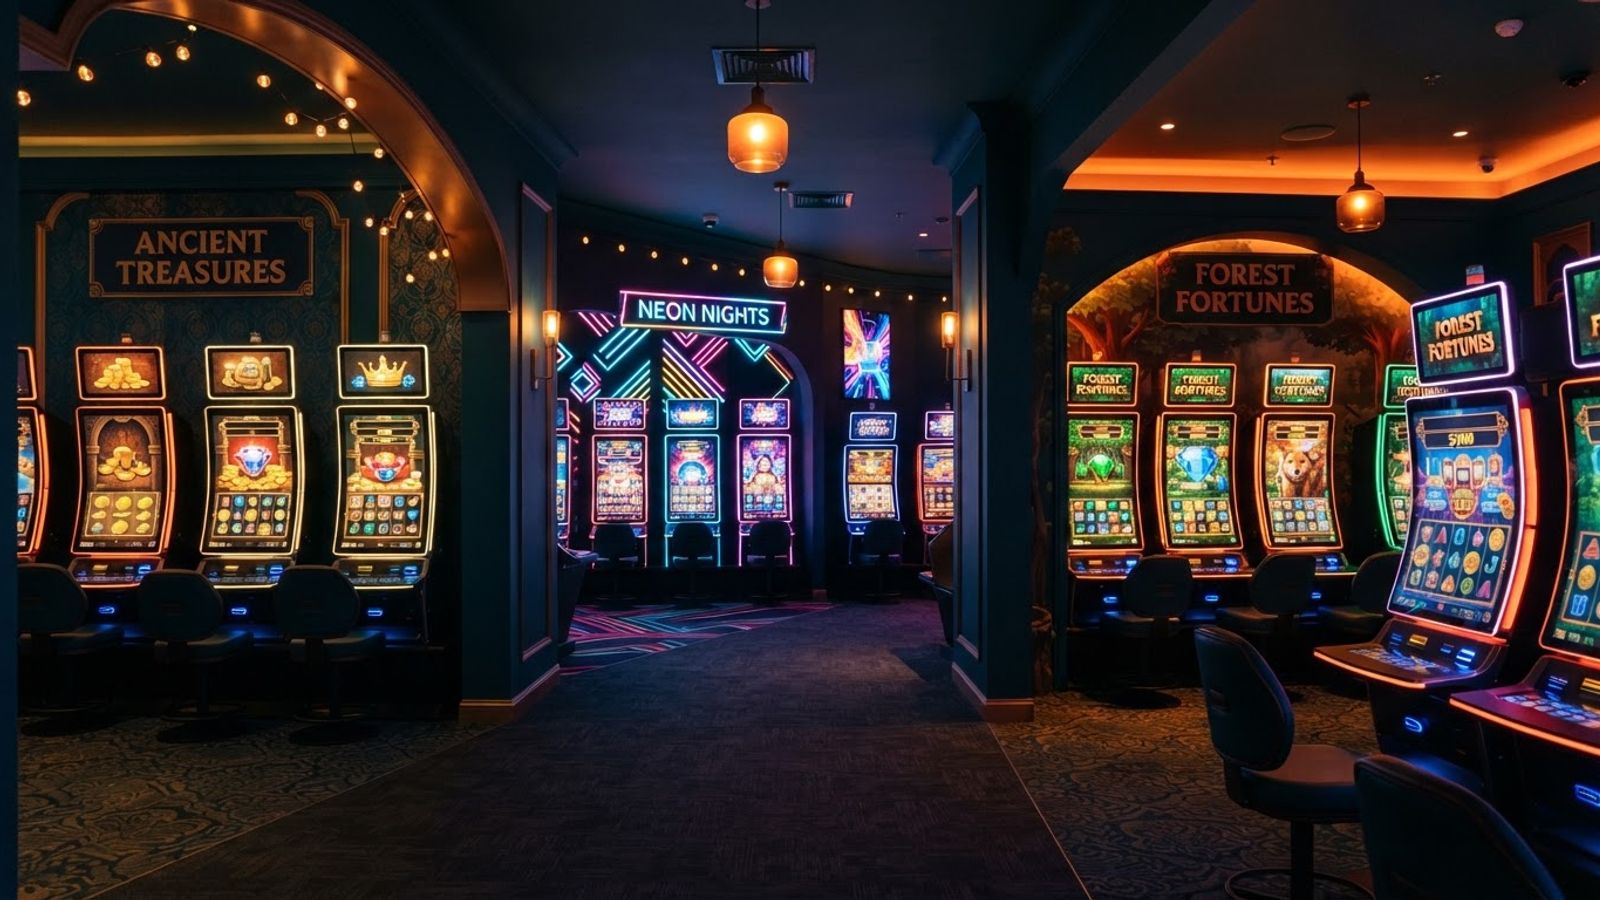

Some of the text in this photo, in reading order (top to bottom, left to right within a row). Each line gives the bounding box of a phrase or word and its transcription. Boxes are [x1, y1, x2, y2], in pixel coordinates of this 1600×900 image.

[134, 229, 268, 255] ANCIENT
[116, 259, 286, 285] TREASURES
[1195, 262, 1295, 286] FOREST
[638, 299, 770, 326] NEON NIGHTS
[1176, 290, 1314, 315] FORTUNES
